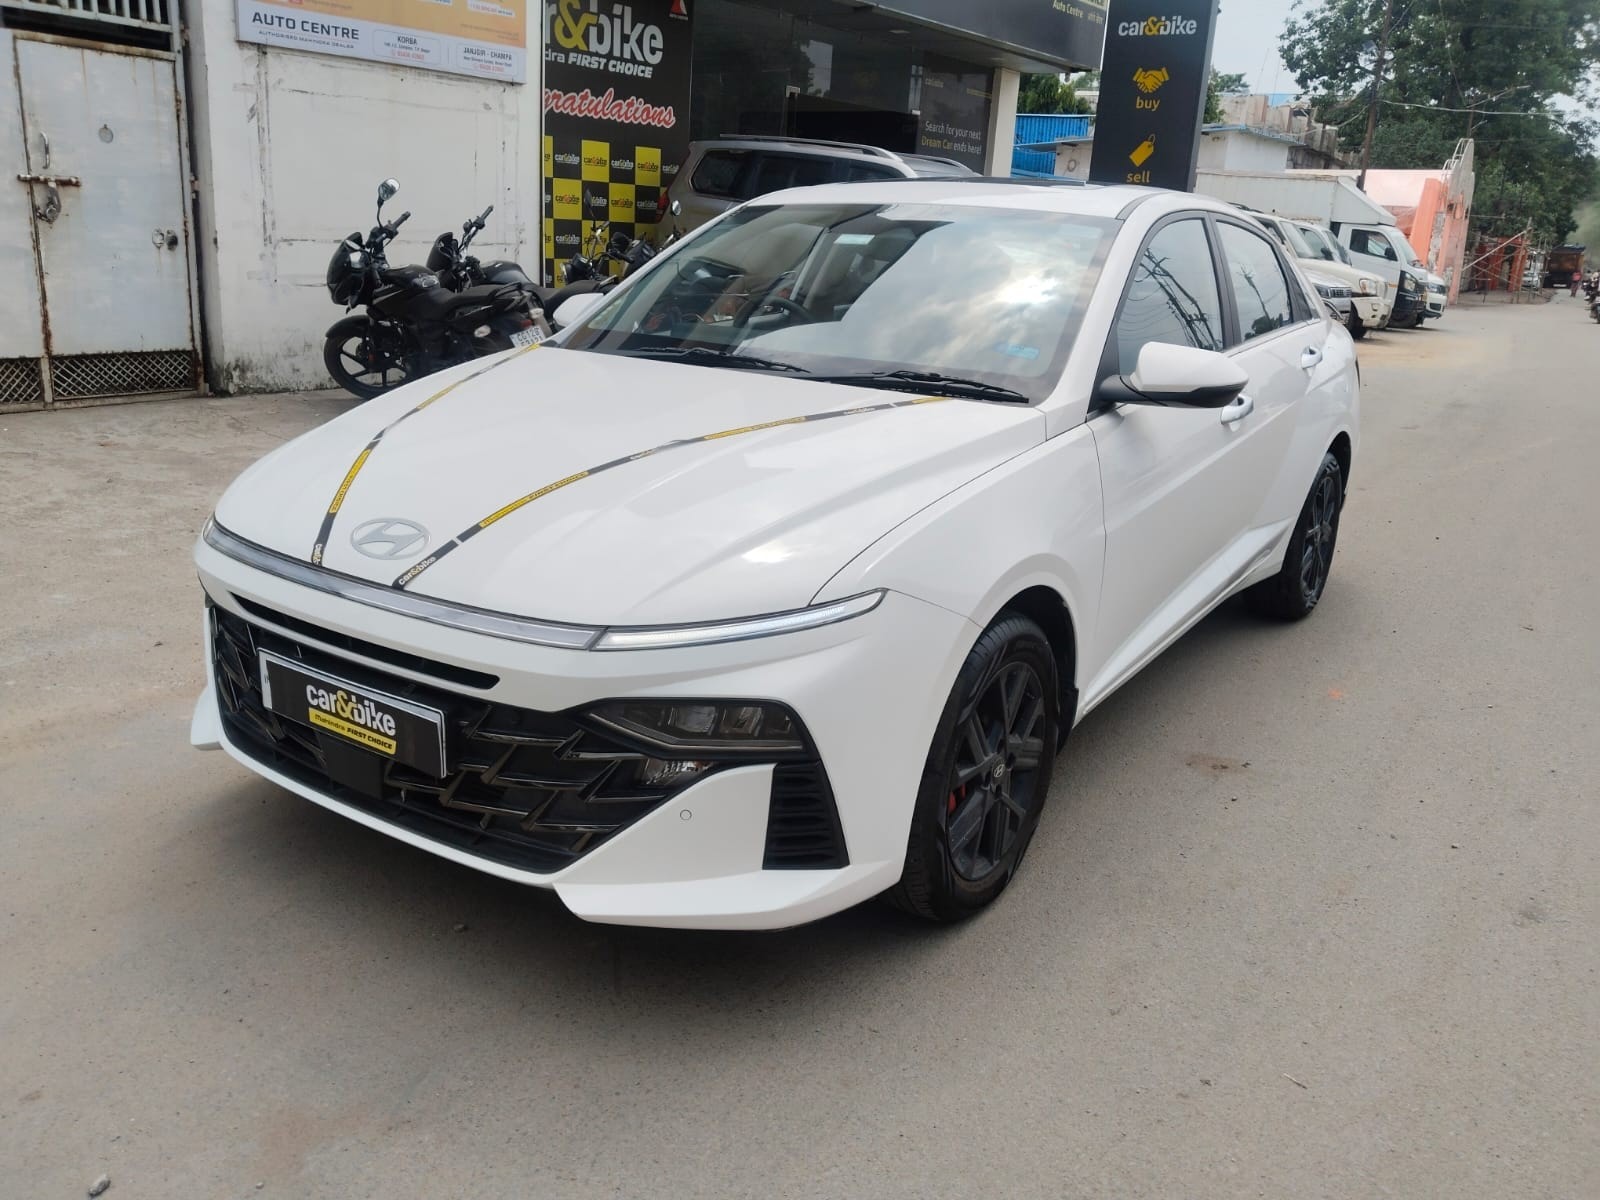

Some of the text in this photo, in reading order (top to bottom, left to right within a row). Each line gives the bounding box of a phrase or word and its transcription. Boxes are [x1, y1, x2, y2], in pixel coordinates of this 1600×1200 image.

[252, 12, 360, 40] AUTO CENTRE
[1118, 16, 1198, 37] car&bike
[397, 36, 418, 46] KORBA
[568, 52, 607, 70] FIRST
[608, 59, 653, 78] CHOICE
[1136, 96, 1161, 112] buy
[925, 121, 945, 134] Search
[921, 136, 942, 149] Dream
[1126, 170, 1151, 183] sell
[306, 684, 396, 736] car&bike
[347, 727, 367, 740] FIRST
[368, 736, 393, 750] CHOICE
